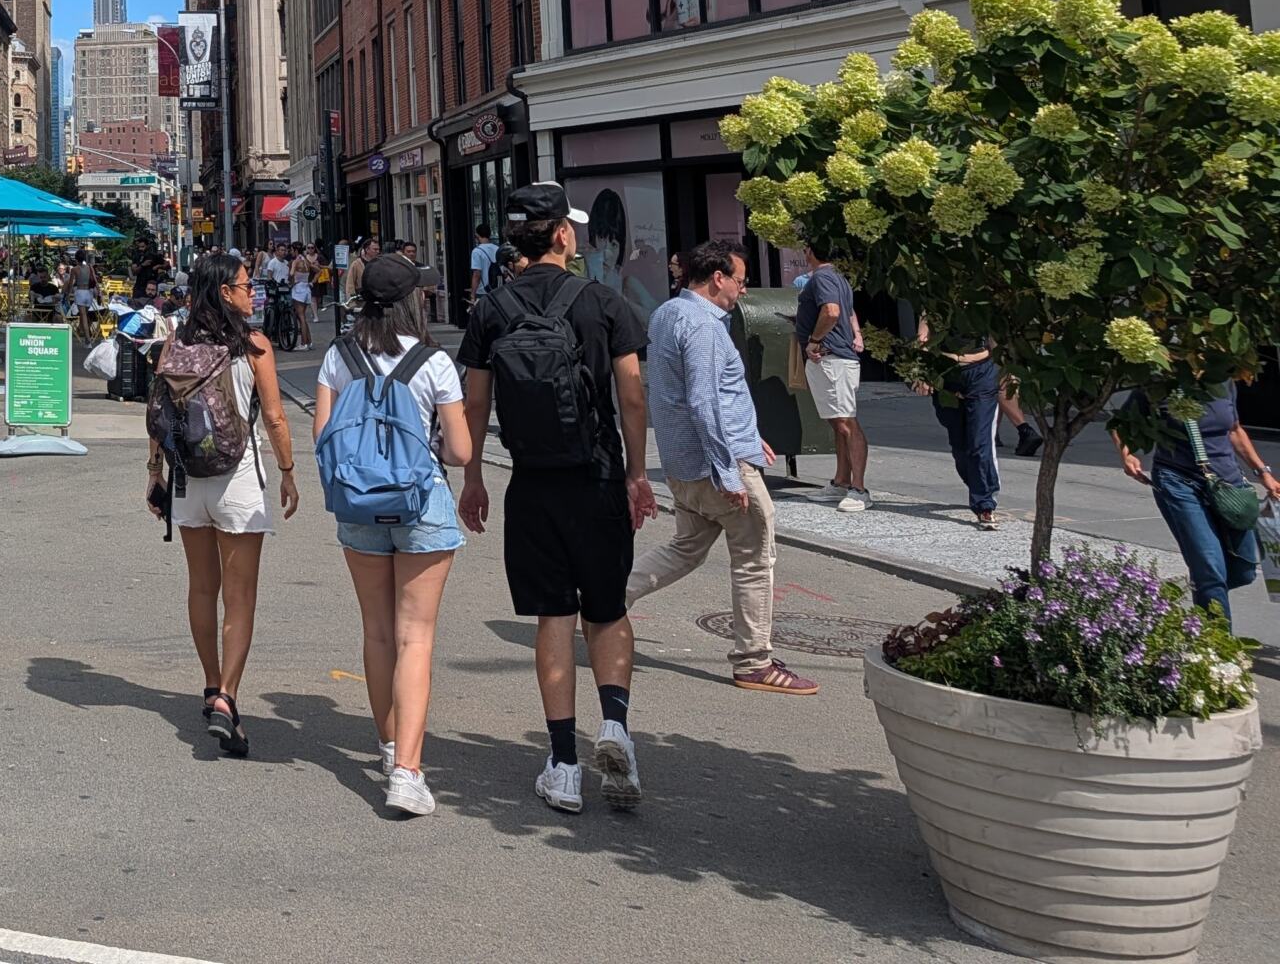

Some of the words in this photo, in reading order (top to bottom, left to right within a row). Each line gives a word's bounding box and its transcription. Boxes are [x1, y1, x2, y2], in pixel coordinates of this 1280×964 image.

[304, 209, 316, 217] sg
[19, 338, 44, 347] UNION
[27, 347, 59, 356] SQUARE
